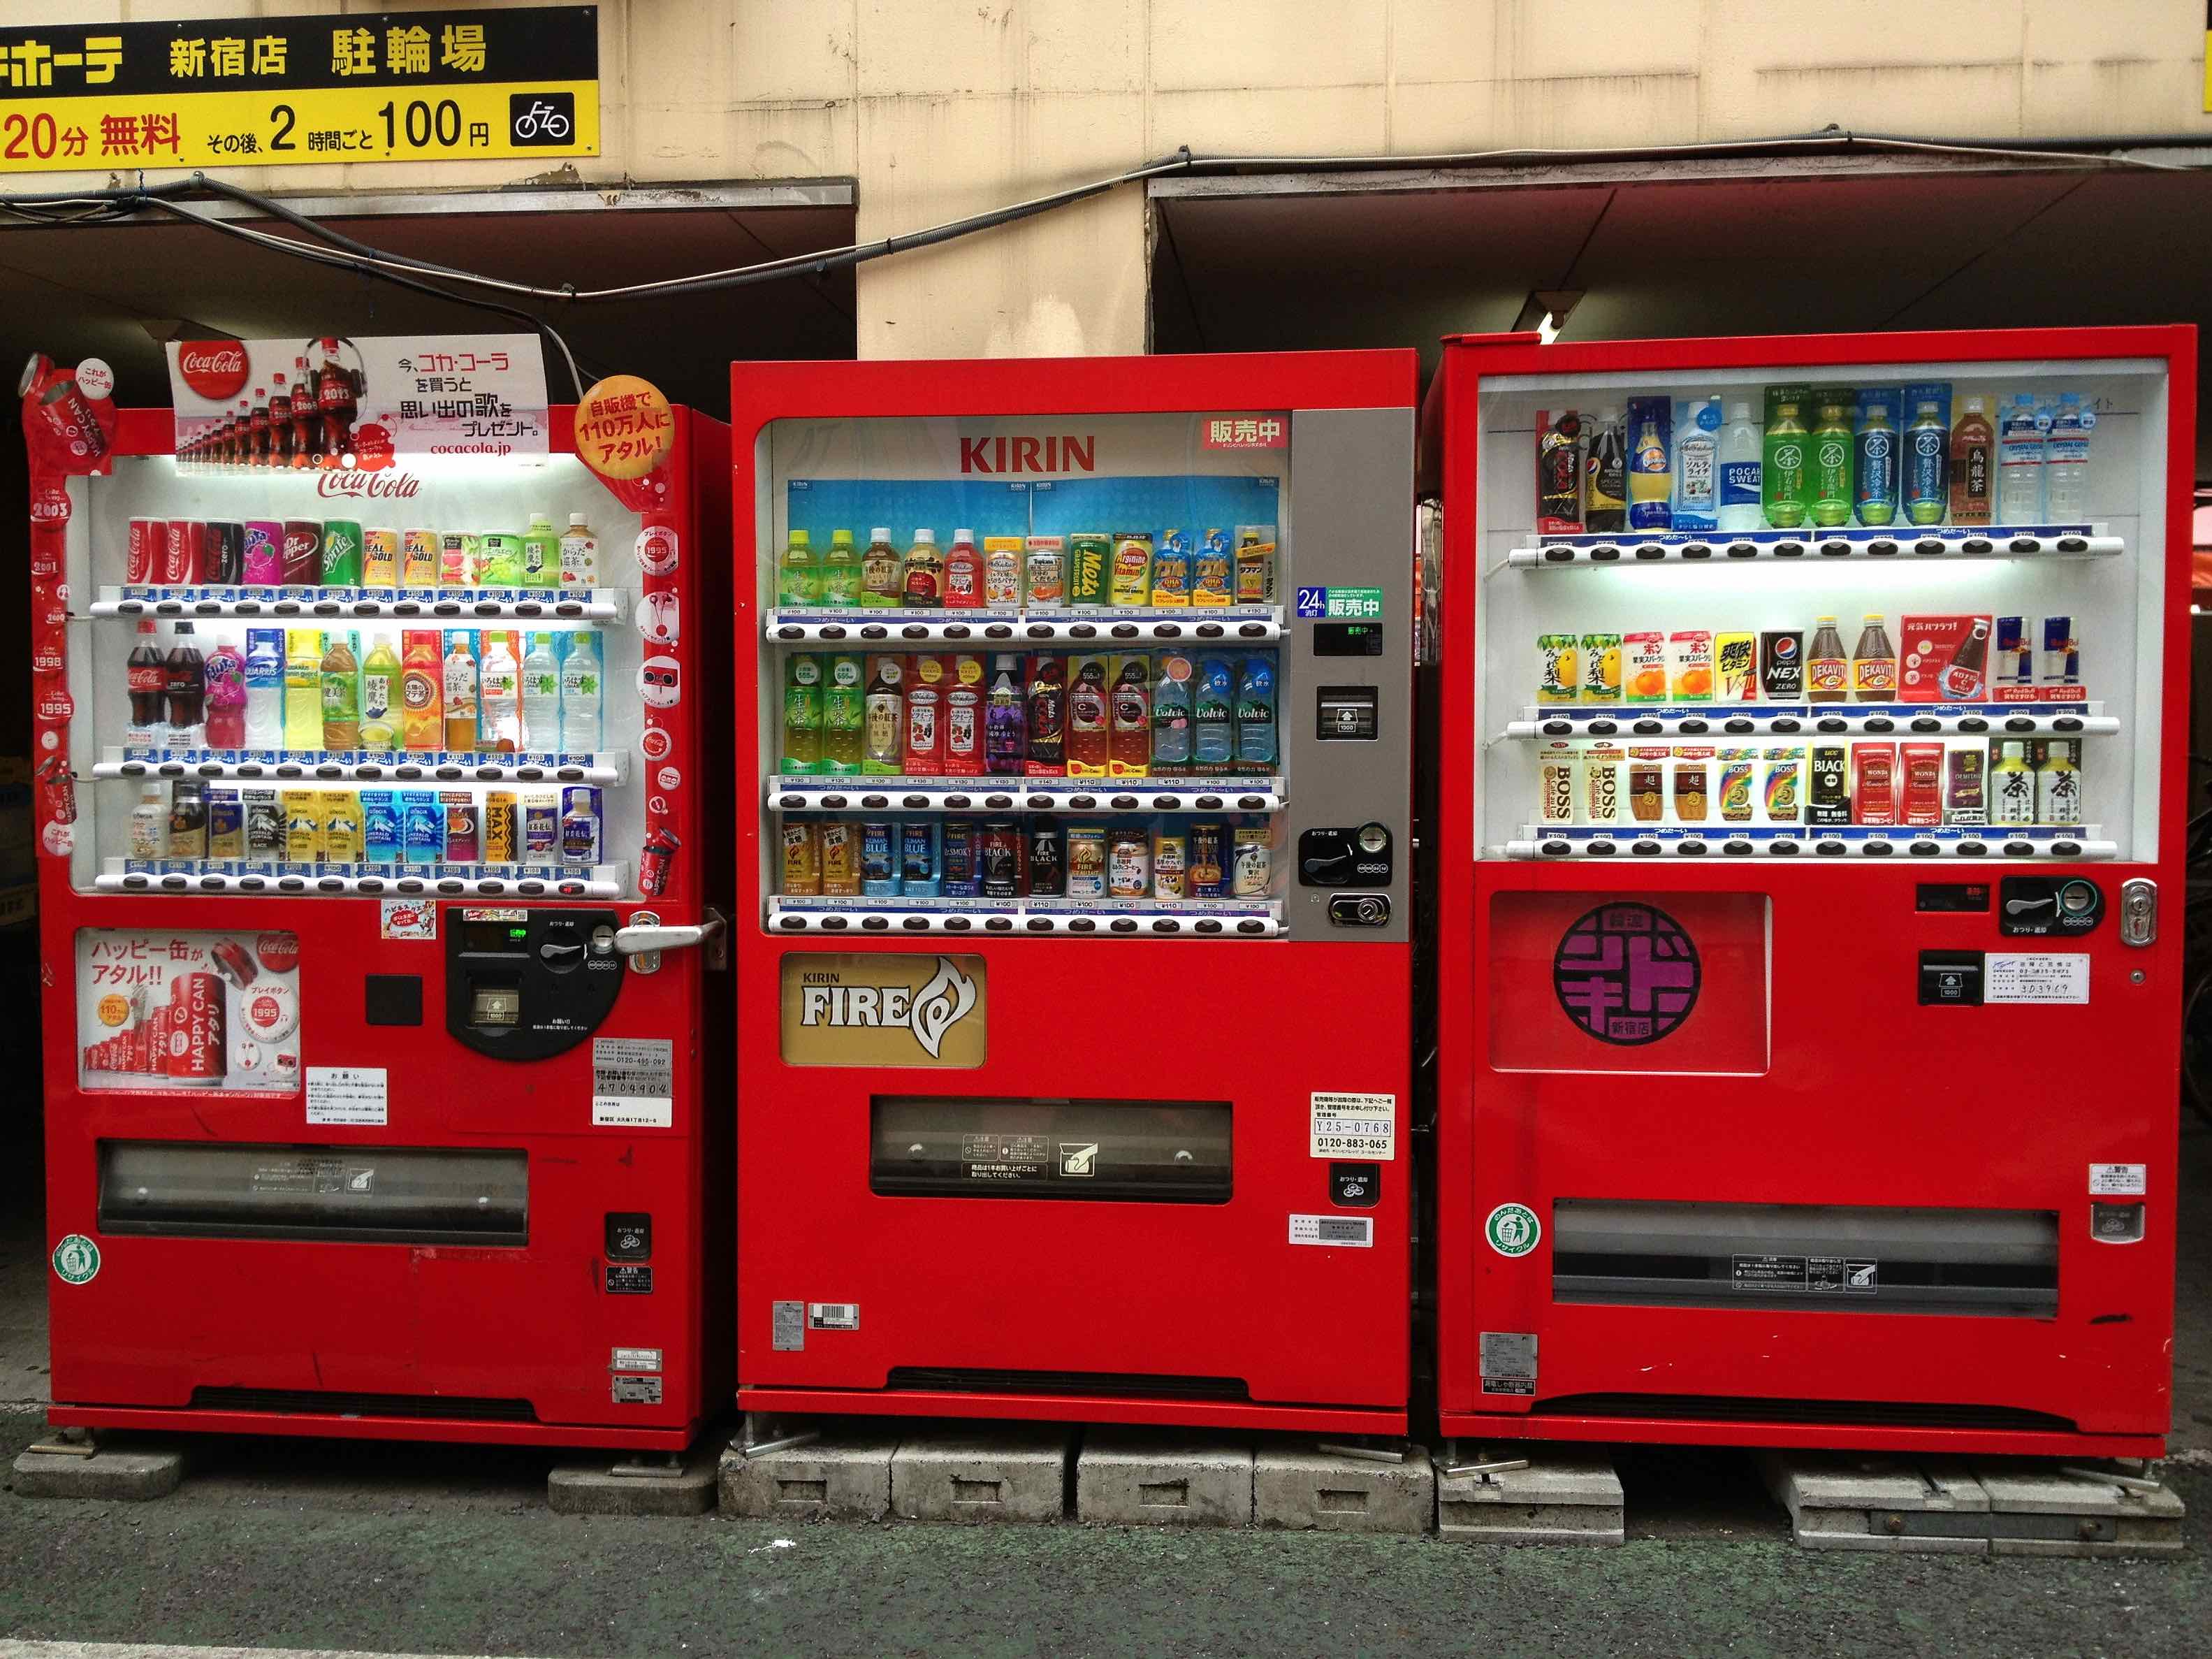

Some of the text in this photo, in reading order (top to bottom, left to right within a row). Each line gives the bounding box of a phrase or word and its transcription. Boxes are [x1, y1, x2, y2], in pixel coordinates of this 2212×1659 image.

[170, 36, 287, 79] 新宿店
[330, 24, 488, 75] 駐輪場
[183, 352, 242, 374] Coca-Cola
[85, 368, 106, 377] これが
[416, 378, 472, 393] を買うと
[400, 393, 512, 419] 思い出の歌を
[590, 391, 653, 416] 自販機で
[579, 412, 671, 441] 110万人に
[1209, 419, 1281, 443] 販売中
[430, 442, 511, 456] cocacola.jp
[1868, 437, 1886, 456] 茶
[1919, 435, 1937, 454] 茶
[960, 435, 1095, 474] KIRIN
[1780, 448, 1798, 467] 茶
[1822, 445, 1841, 464] 茶
[1971, 448, 1986, 493] 烏龍茶
[33, 502, 67, 516] 2003
[167, 528, 180, 581] Coca-Cola
[323, 536, 348, 572] Sprite
[373, 553, 393, 562] GOLD
[413, 553, 433, 562] GOLD
[1082, 551, 1103, 595] Mets
[1298, 589, 1325, 611] 24h
[1328, 598, 1380, 616] 販売中
[1347, 626, 1369, 635] 販売中
[35, 657, 61, 669] 1998
[1722, 659, 1749, 672] ビタミン
[1768, 666, 1800, 681] NEX
[40, 702, 71, 715] 1995
[792, 695, 805, 725] 生茶
[831, 695, 845, 726] 生茶
[1155, 707, 1185, 718] Volvic
[1195, 708, 1228, 718] Volvic
[1237, 707, 1269, 718] Volvic
[1728, 765, 1749, 774] BOSS
[1774, 765, 1796, 774] BOSS
[1814, 760, 1846, 772] BLACK
[1644, 774, 1657, 785] 超
[1688, 774, 1700, 785] 超
[2002, 771, 2030, 799] 茶
[2050, 771, 2079, 799] 茶
[1556, 766, 1571, 819] BOSS
[1601, 766, 1616, 819] BOSS
[492, 807, 502, 841] MAX
[866, 843, 889, 853] BLUE
[904, 843, 926, 853] BLUE
[984, 848, 1012, 857] BLACK
[1241, 861, 1267, 869] 午後の紅茶
[92, 939, 203, 961] ハッピー缶が
[259, 940, 299, 955] Coca-Cola
[803, 972, 840, 983] KIRIN
[254, 1008, 277, 1017] 1995
[801, 984, 911, 1029] FIRE
[191, 978, 205, 1071] HAPPY CAN
[208, 1003, 220, 1045] アタリ
[1611, 1021, 1650, 1035] 新宿店
[1316, 1120, 1389, 1133] Y25-0768
[1318, 1138, 1388, 1149] 0120-883-065
[1494, 1206, 1534, 1224] のんだあとは
[1495, 1239, 1530, 1254] リサイクル
